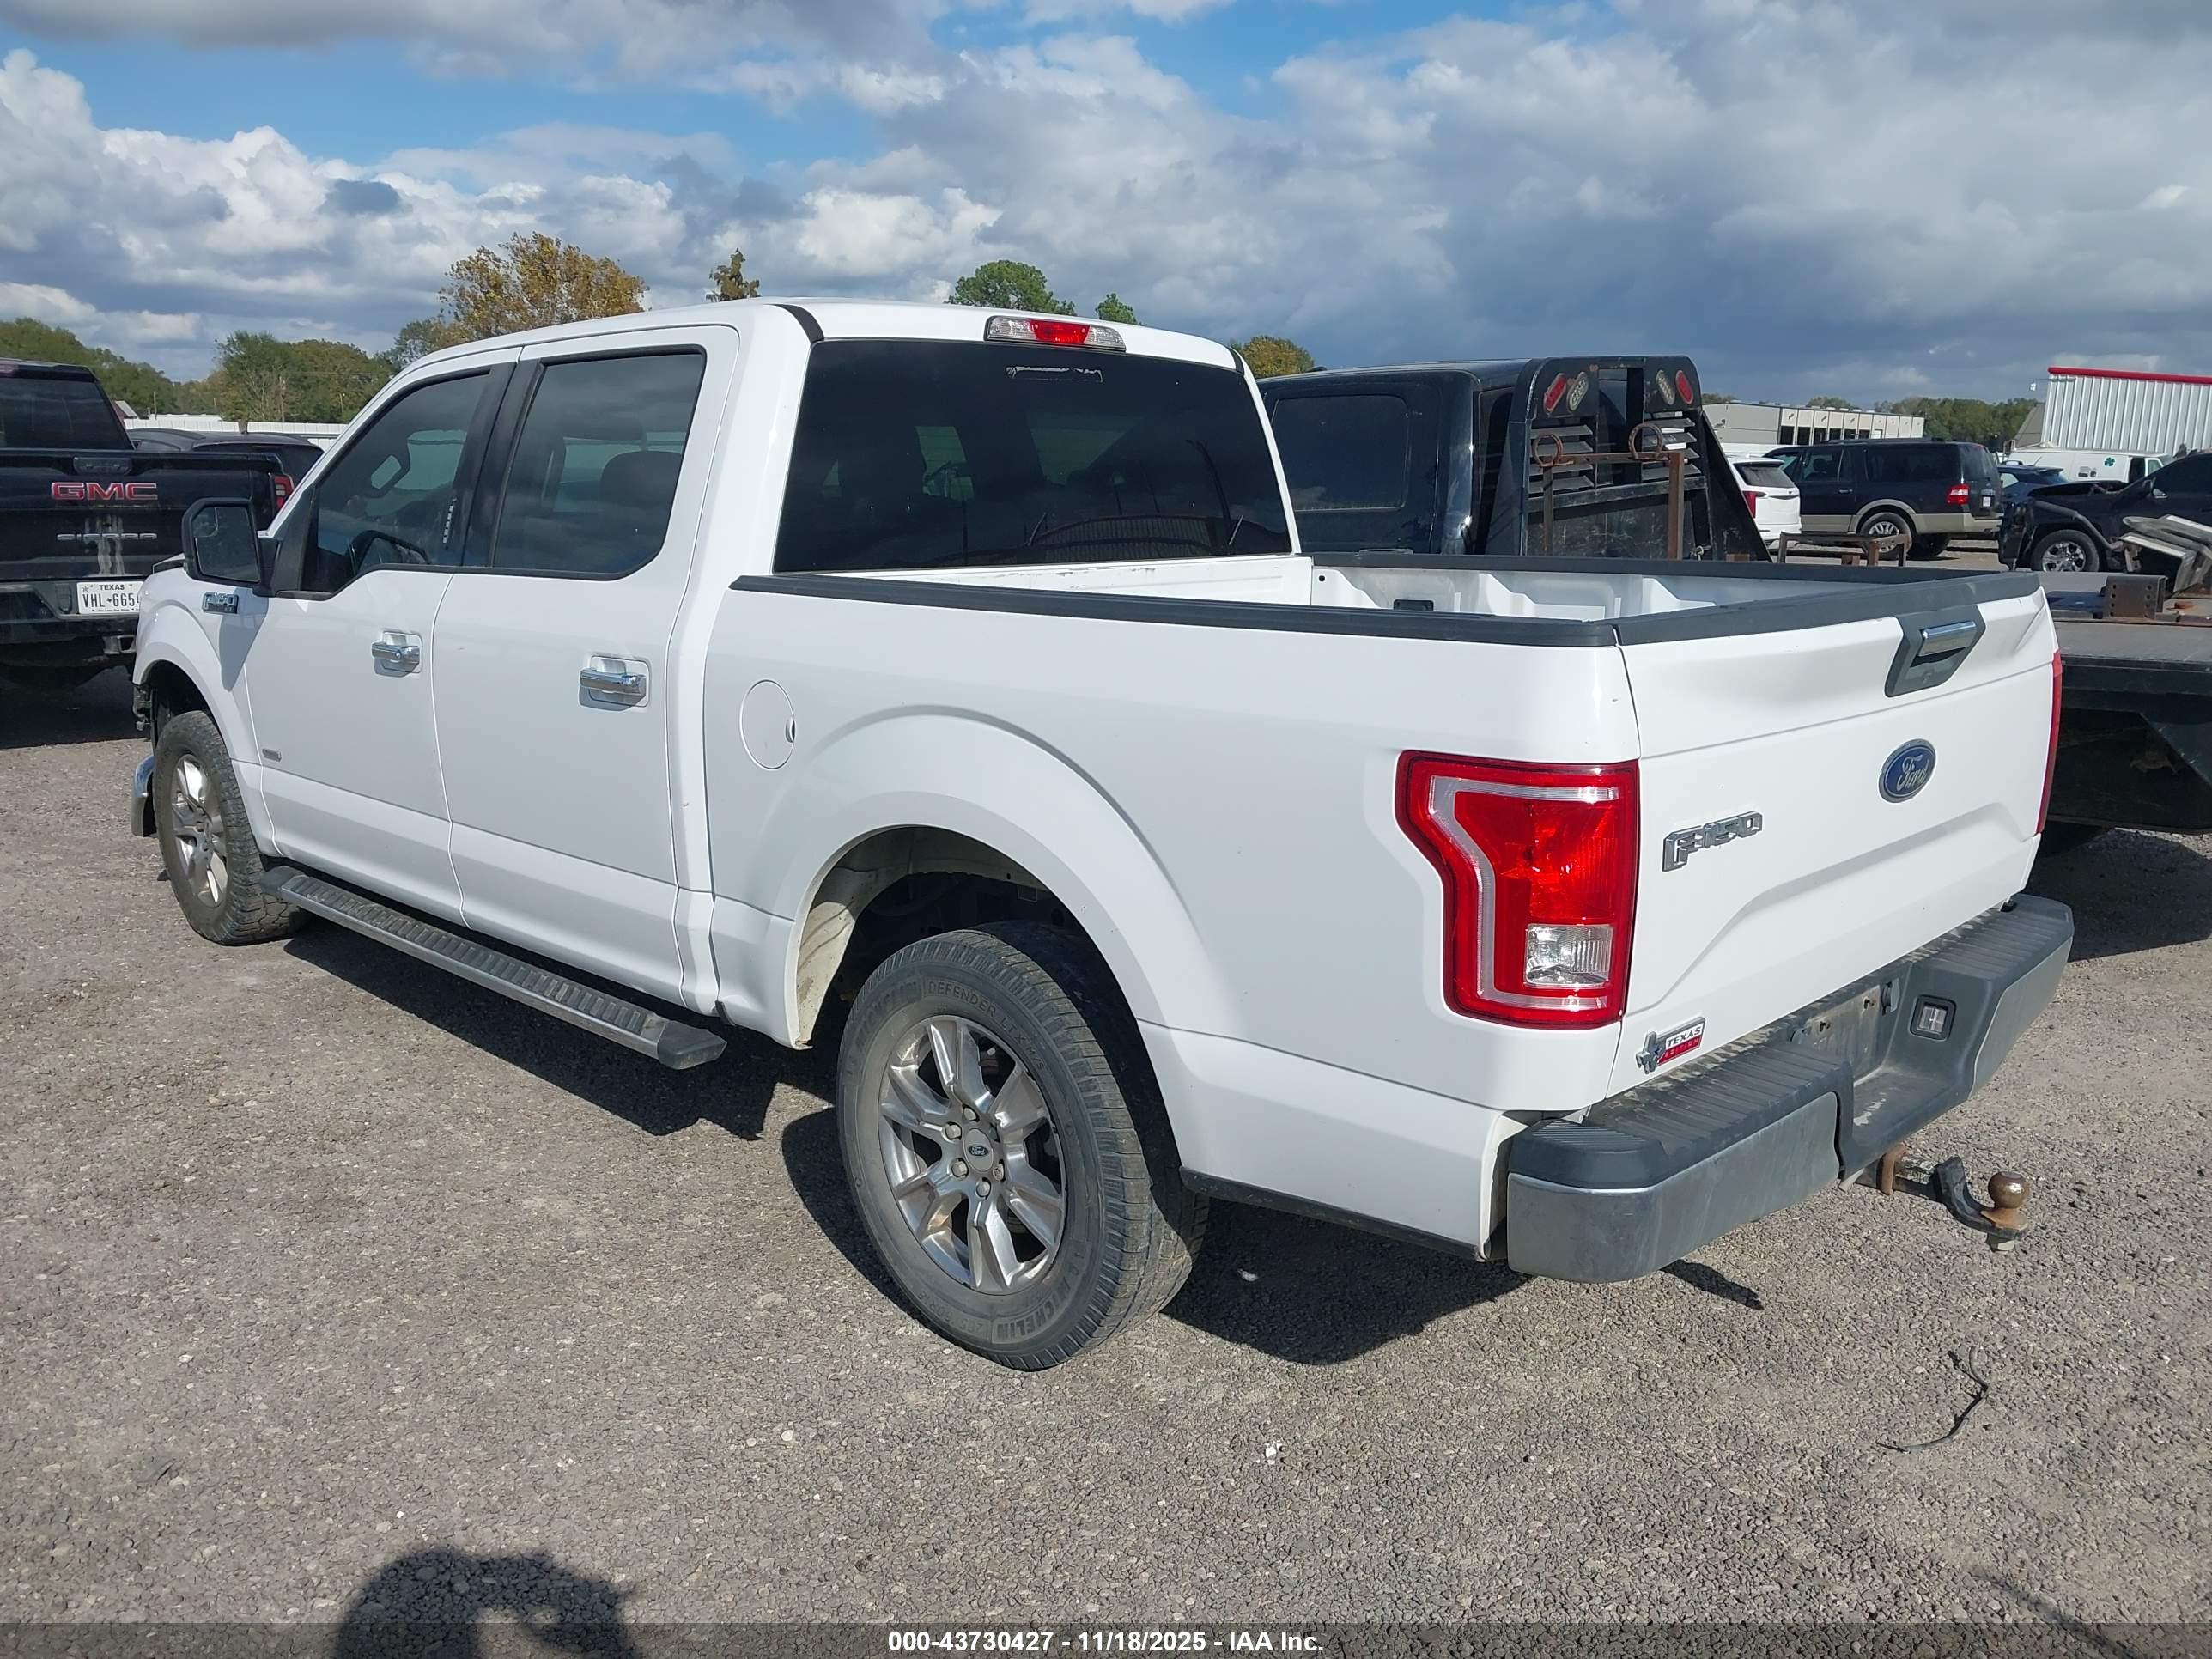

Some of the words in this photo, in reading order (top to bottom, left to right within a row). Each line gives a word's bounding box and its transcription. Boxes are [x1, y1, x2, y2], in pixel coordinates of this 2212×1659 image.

[52, 482, 158, 501] GMC
[112, 592, 140, 607] 665
[1896, 753, 1930, 792] Ford
[927, 981, 997, 1018] DEFENDER
[1000, 1016, 1027, 1044] LTX
[1667, 1025, 1702, 1048] TEXAS
[996, 1277, 1072, 1338] MICHELIN
